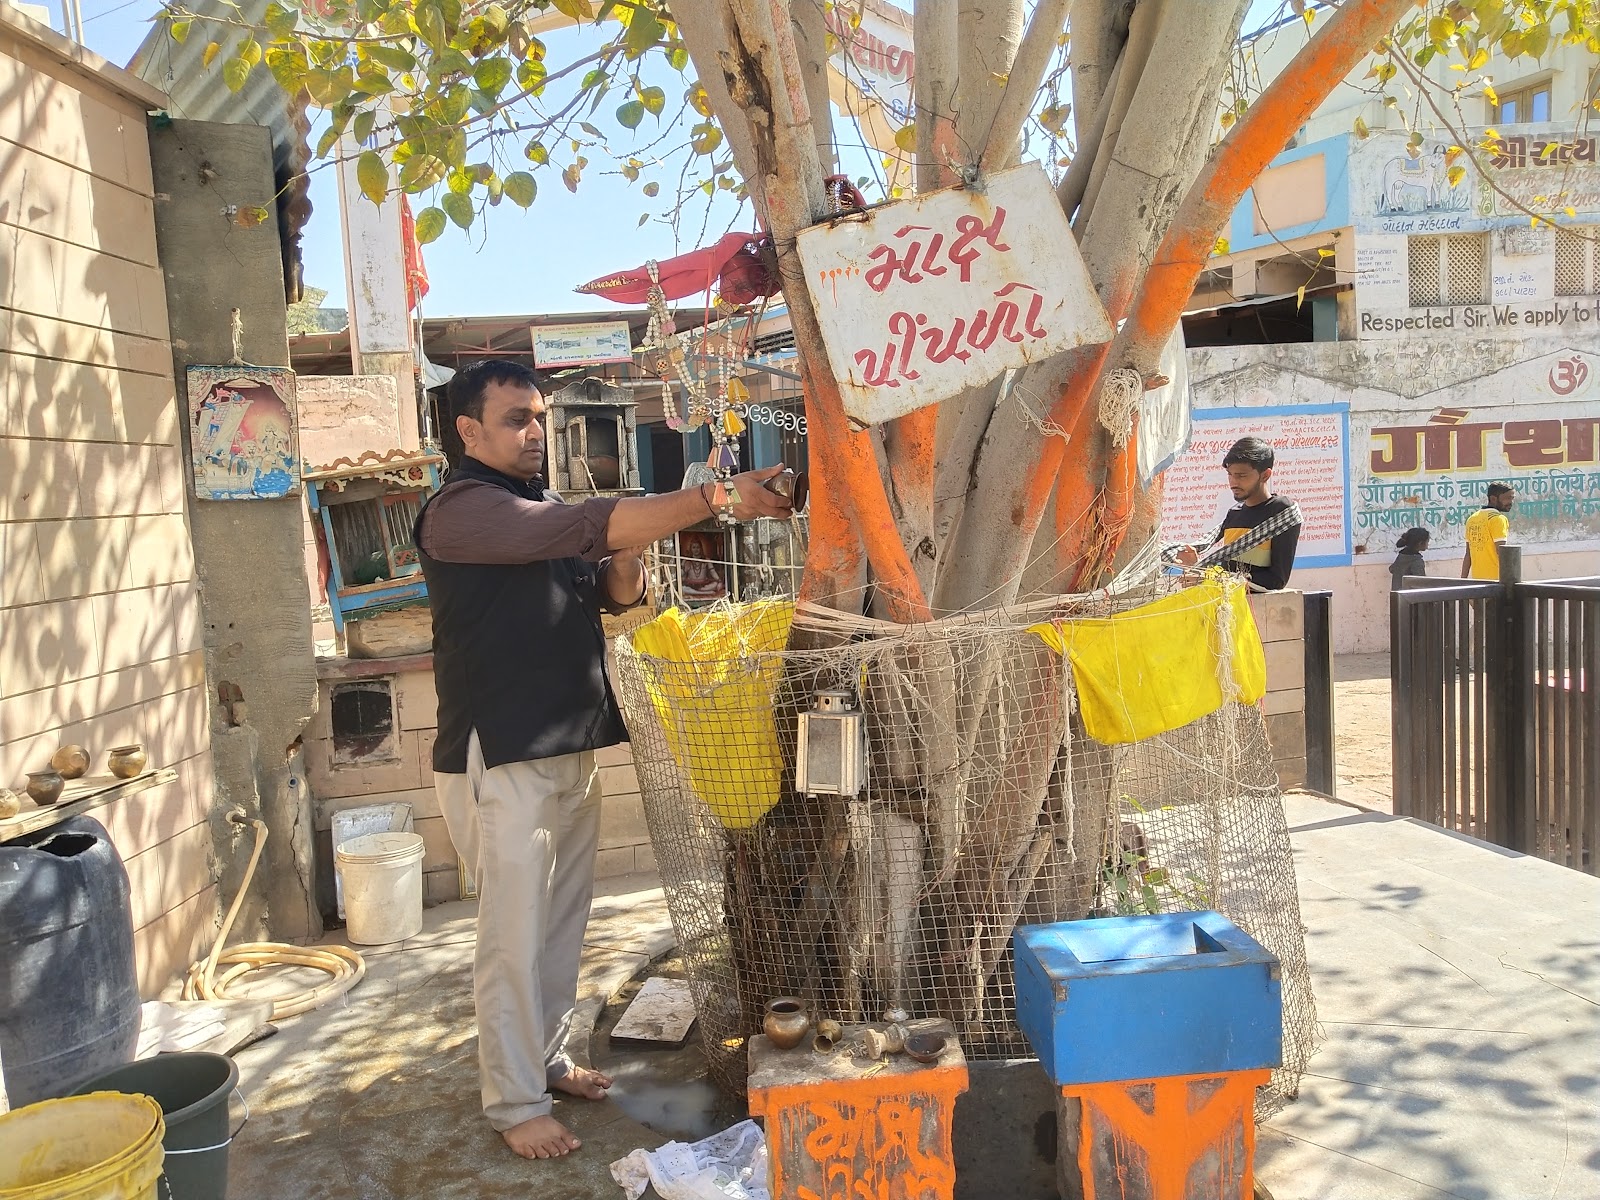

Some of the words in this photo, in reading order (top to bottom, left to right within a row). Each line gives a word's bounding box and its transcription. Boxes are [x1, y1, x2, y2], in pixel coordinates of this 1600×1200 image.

[1361, 308, 1454, 332] Respected
[1493, 304, 1519, 326] We
[1525, 302, 1568, 327] apply
[1572, 302, 1590, 322] to
